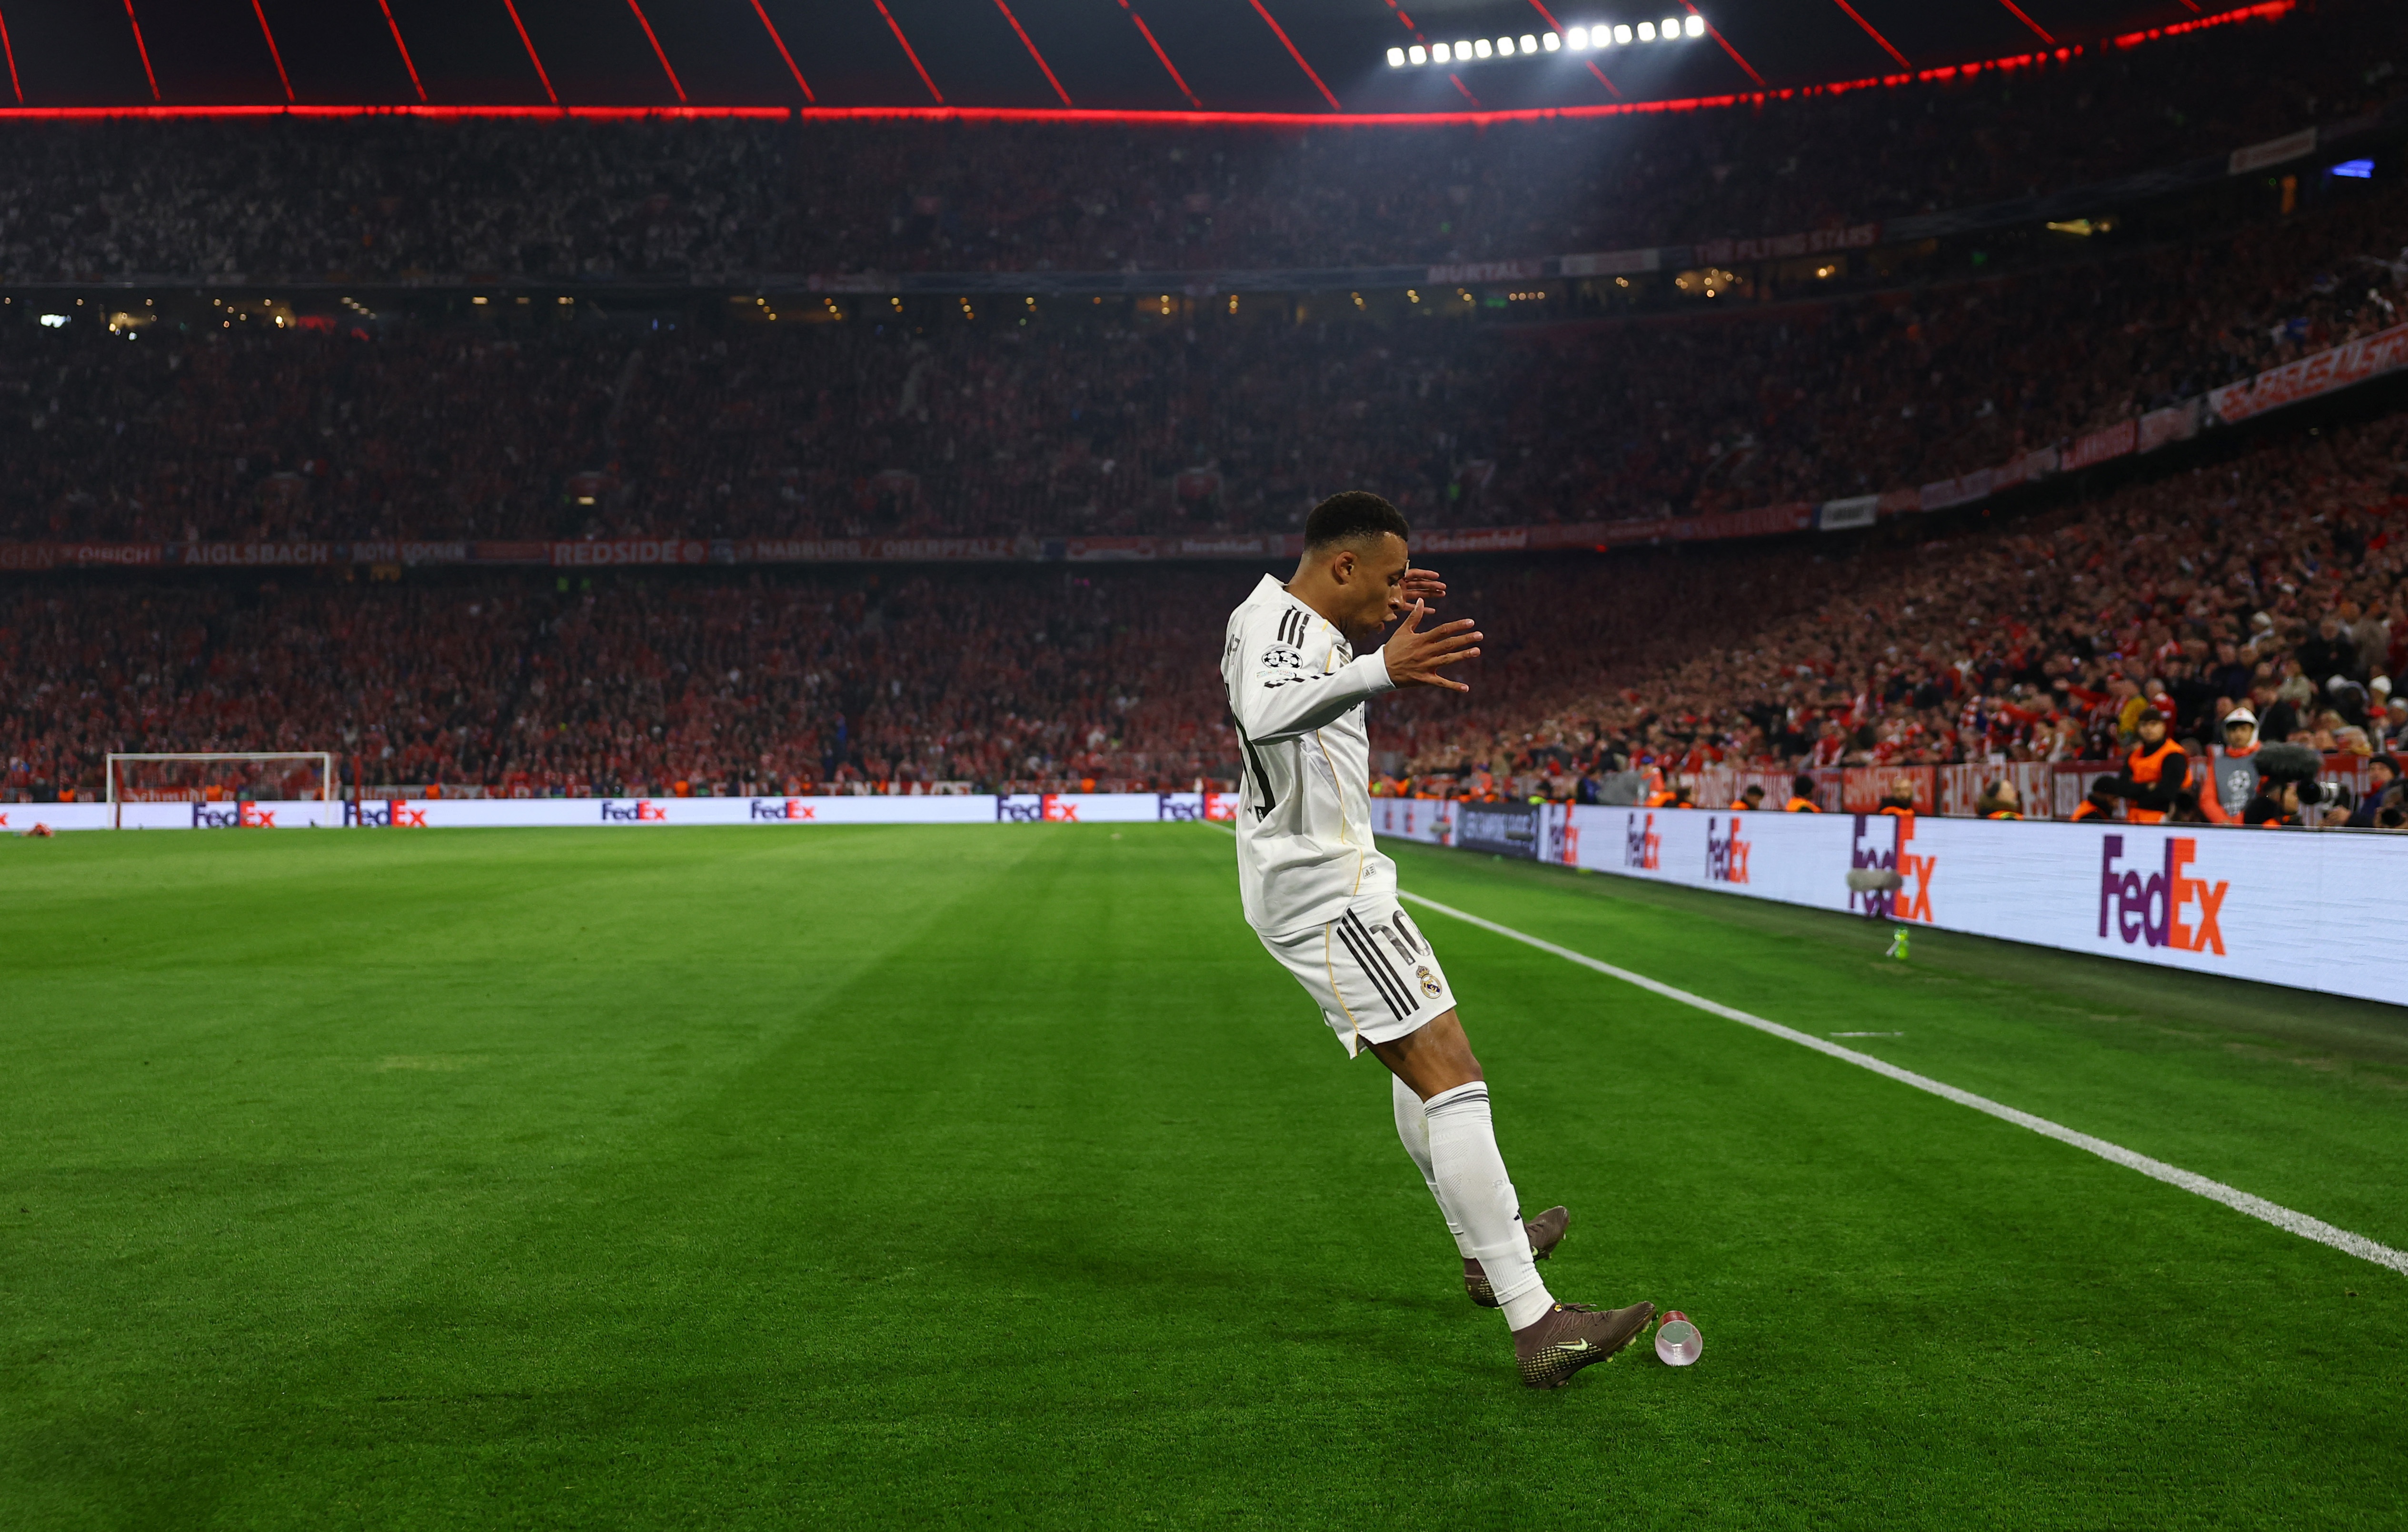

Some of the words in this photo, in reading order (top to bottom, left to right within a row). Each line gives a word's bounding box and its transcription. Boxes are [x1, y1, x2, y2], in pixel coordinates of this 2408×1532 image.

[185, 542, 327, 564] AIGLSBACH
[554, 541, 679, 565] REDSIDE
[193, 801, 275, 827] FedEx
[345, 800, 427, 827] FedEx
[602, 800, 666, 820] FedEx
[751, 799, 815, 820] FedEx
[998, 794, 1079, 822] FedEx
[1160, 794, 1237, 821] FedEx
[1705, 817, 1751, 884] FedEx
[1850, 814, 1937, 922] FedEx
[2098, 834, 2229, 956] FedEx
[1369, 910, 1431, 965] 10
